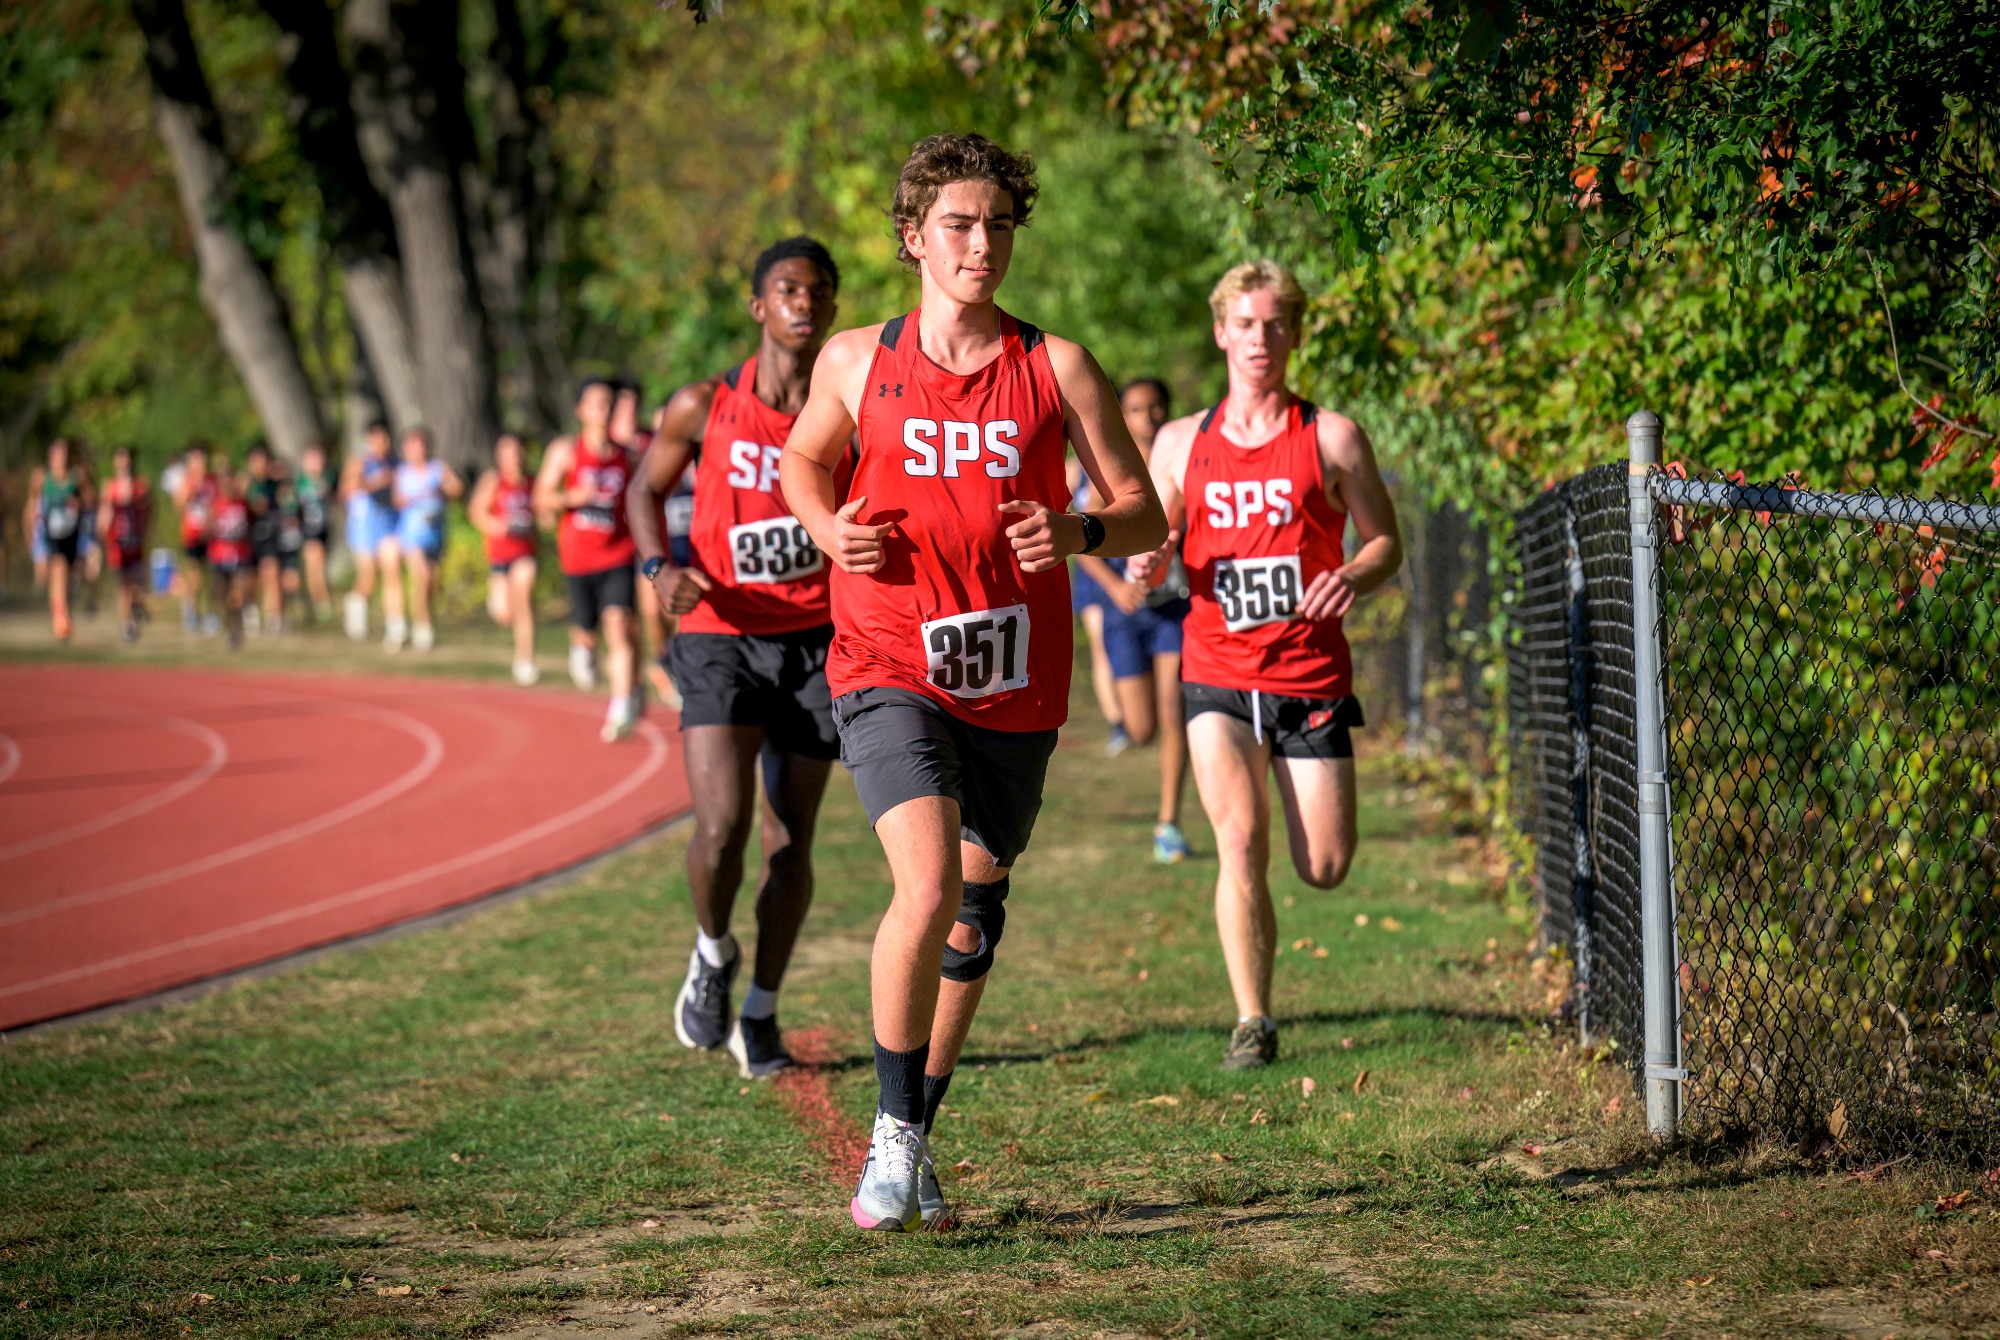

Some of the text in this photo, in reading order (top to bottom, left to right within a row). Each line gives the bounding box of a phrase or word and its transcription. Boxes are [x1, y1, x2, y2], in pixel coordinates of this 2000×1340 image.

[728, 440, 781, 493] SP
[903, 417, 1020, 478] SPS
[1204, 478, 1293, 529] SPS
[737, 524, 817, 575] 338
[1216, 565, 1297, 622] 359
[929, 615, 1018, 691] 351
